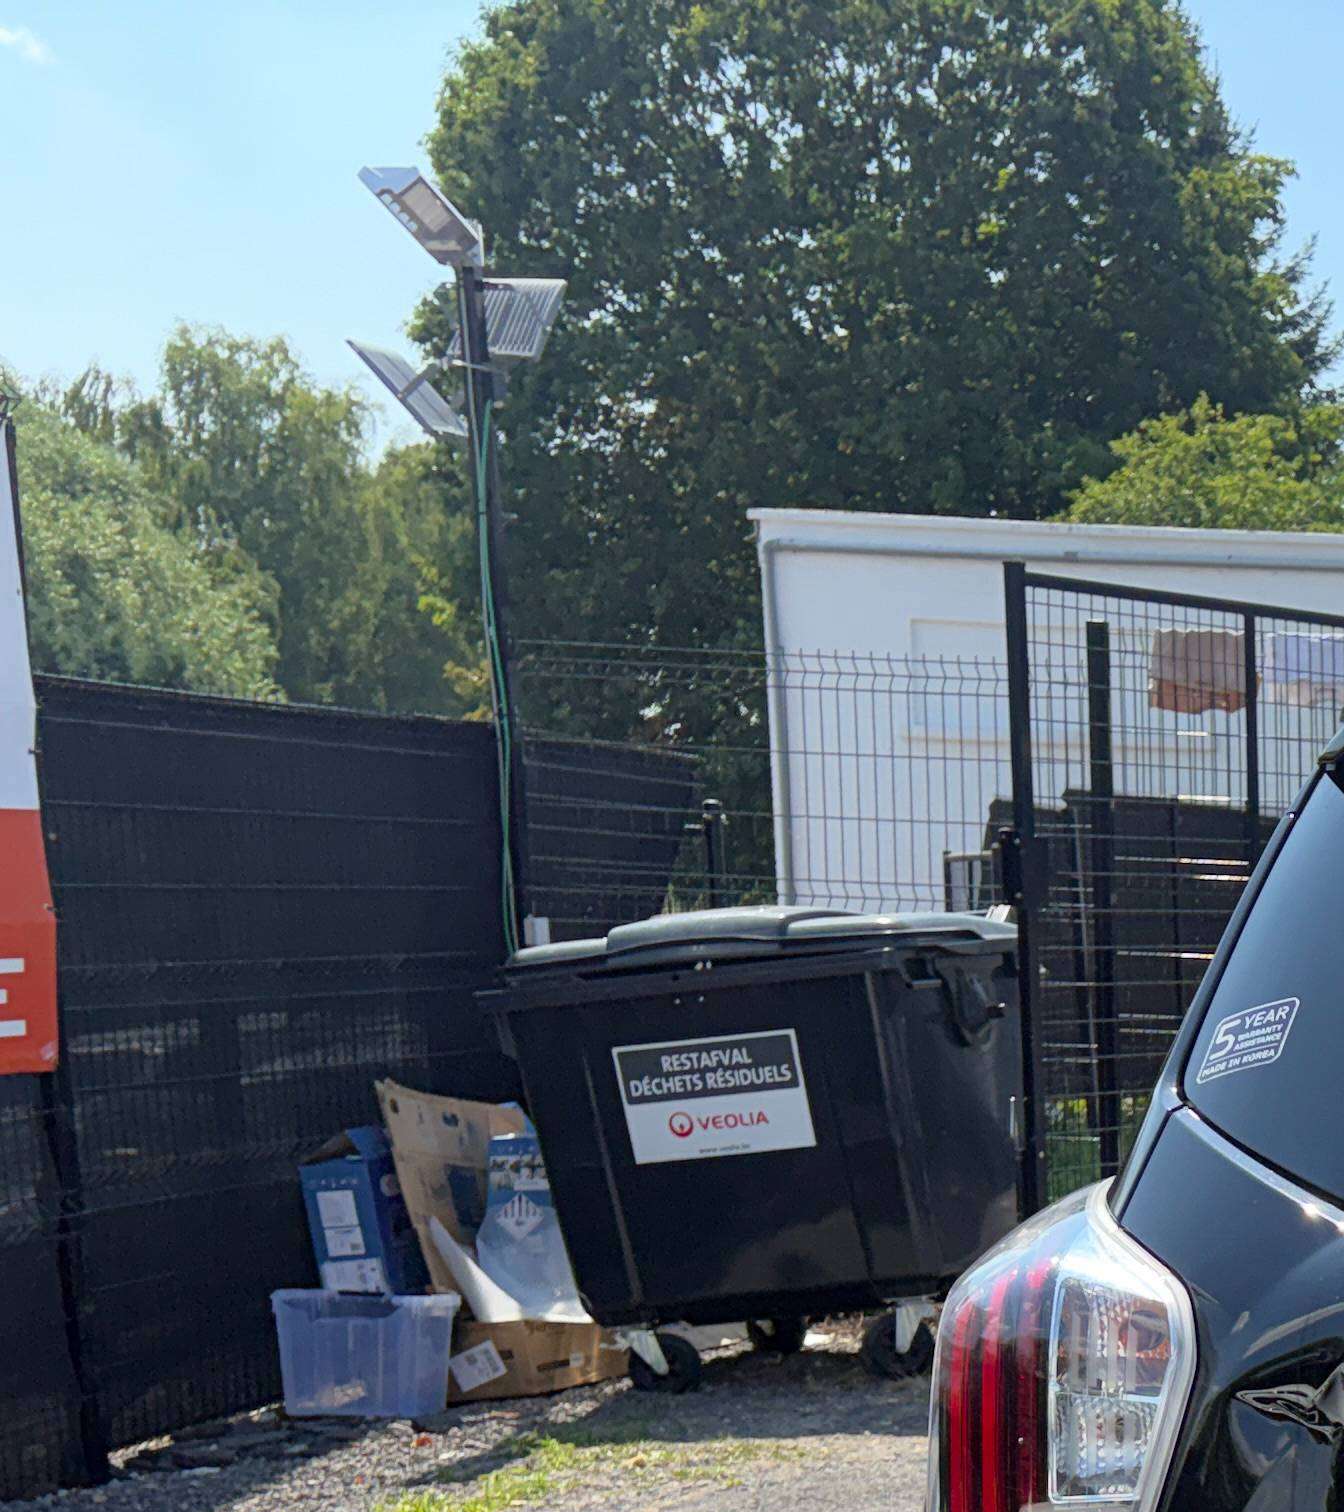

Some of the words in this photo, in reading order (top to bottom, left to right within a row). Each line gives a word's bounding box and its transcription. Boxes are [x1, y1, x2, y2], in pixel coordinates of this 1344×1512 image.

[1209, 1019, 1241, 1060] 5
[1244, 1005, 1290, 1029] YEAR
[660, 1047, 753, 1073] RESTAFVAL
[1202, 1061, 1227, 1077] MADE
[1228, 1057, 1241, 1068] IN
[1242, 1048, 1275, 1063] KOREA
[629, 1073, 701, 1098] DÉCHETS
[705, 1063, 792, 1090] RÉSIDUELS
[696, 1111, 769, 1131] VEOLIA
